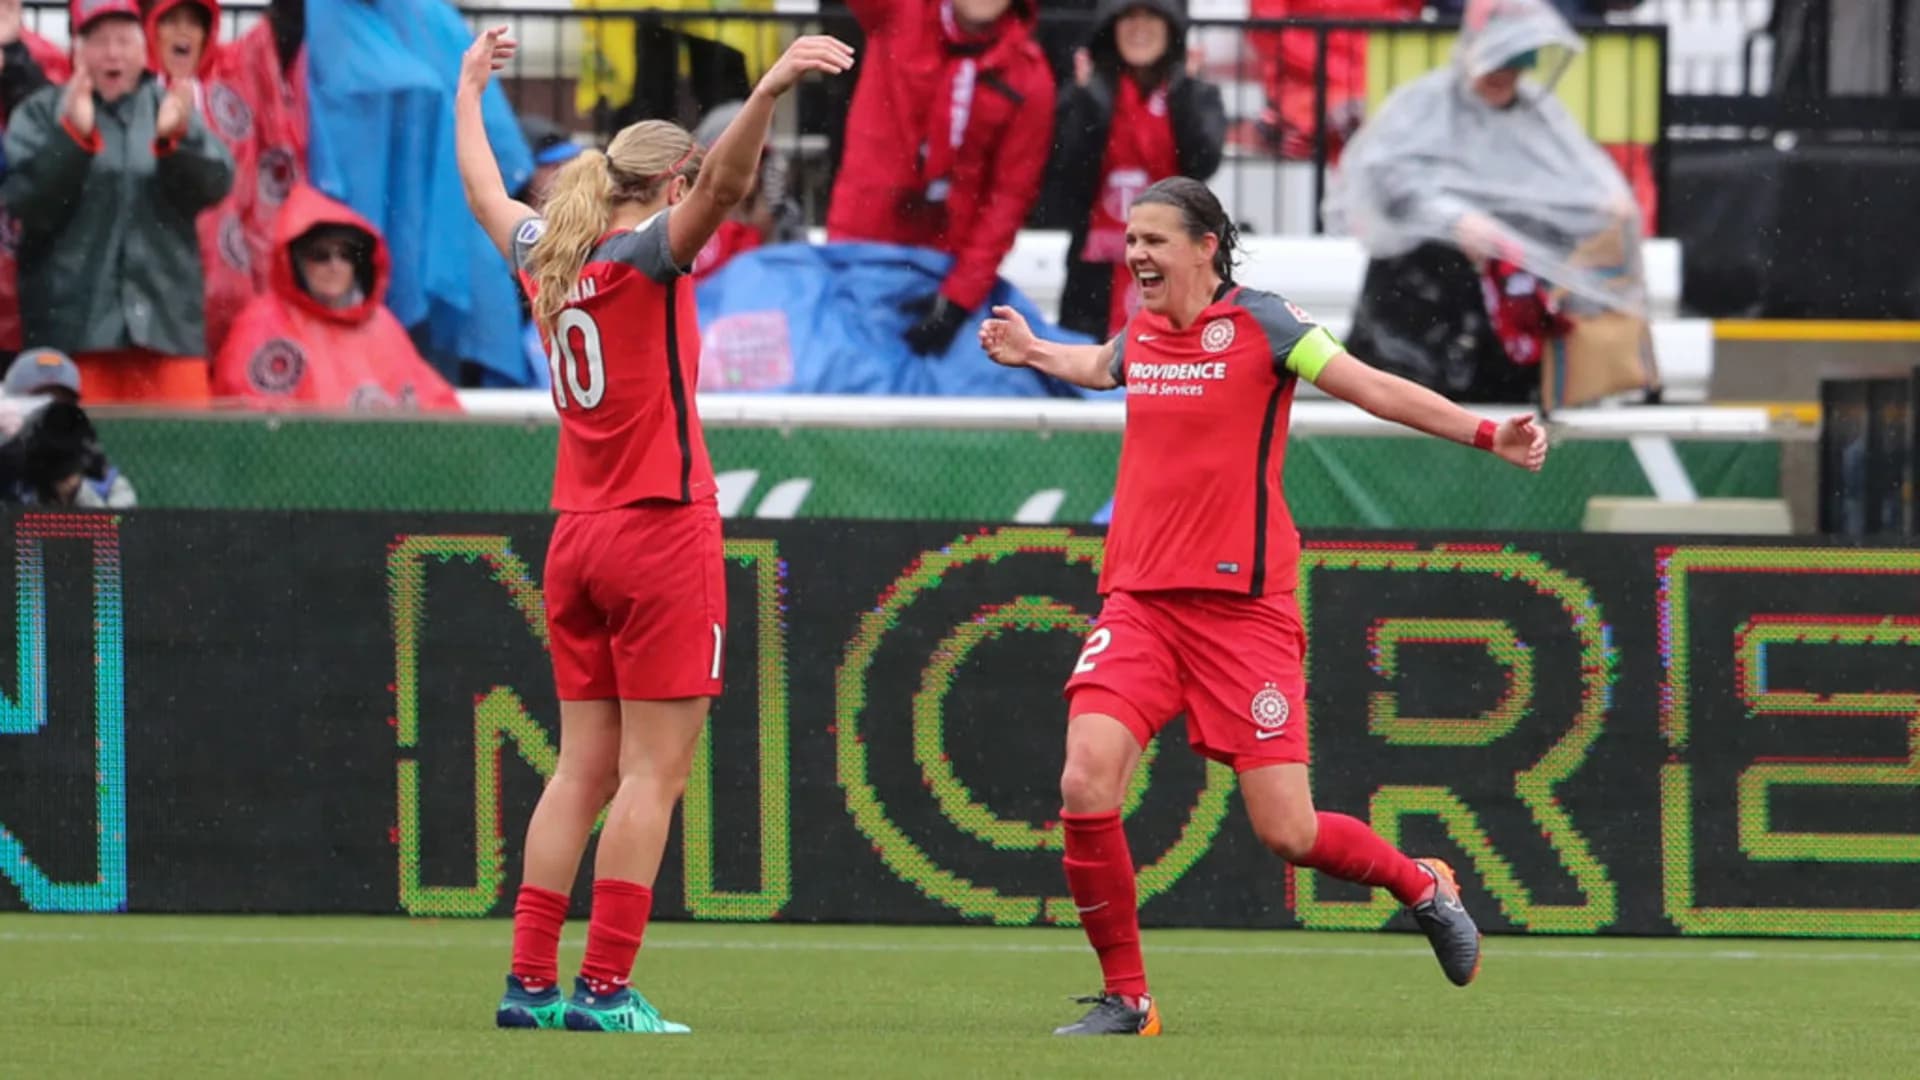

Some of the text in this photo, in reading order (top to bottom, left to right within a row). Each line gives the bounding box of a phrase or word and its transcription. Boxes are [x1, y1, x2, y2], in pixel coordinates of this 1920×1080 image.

[549, 307, 605, 410] 10
[1127, 362, 1227, 379] PROVIDENCE
[1148, 383, 1158, 395] &
[1158, 383, 1204, 396] Services
